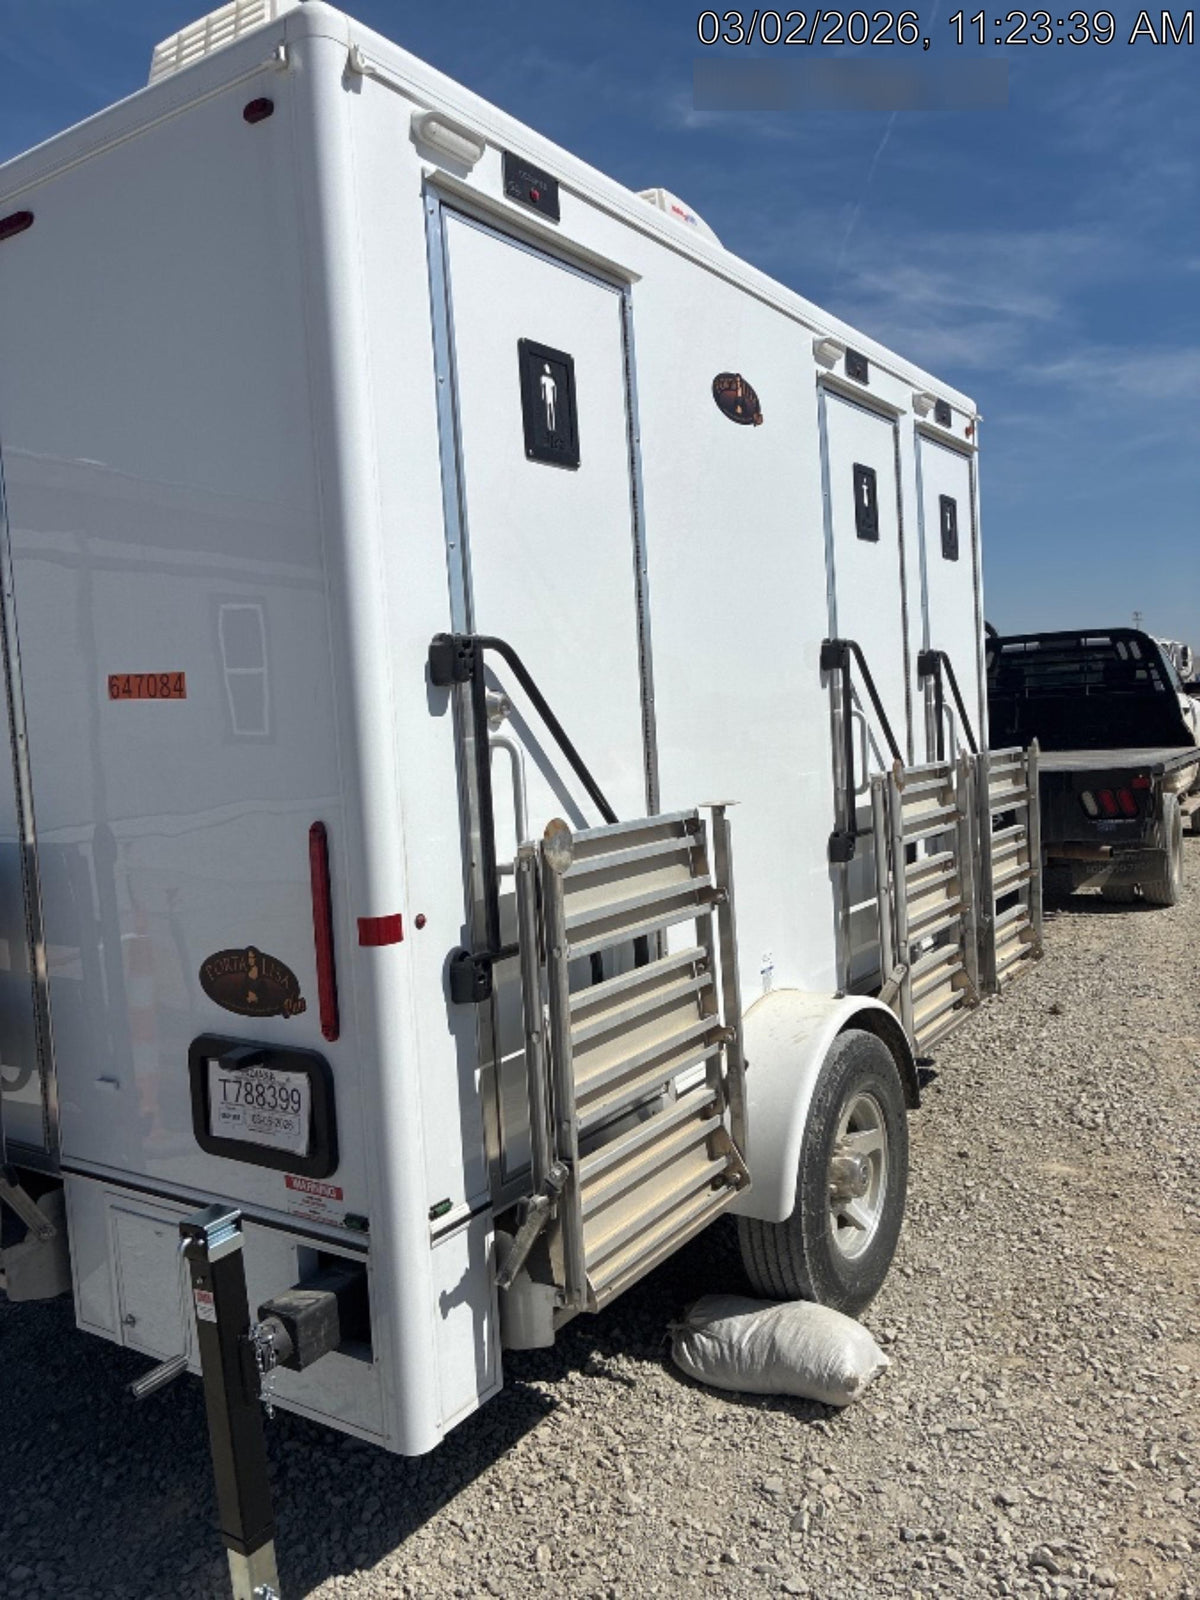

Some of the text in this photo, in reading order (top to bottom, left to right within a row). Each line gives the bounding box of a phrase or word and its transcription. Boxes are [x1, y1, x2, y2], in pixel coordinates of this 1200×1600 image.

[110, 672, 184, 700] 647084
[218, 1078, 301, 1114] T788399
[293, 1177, 337, 1199] WARNING
